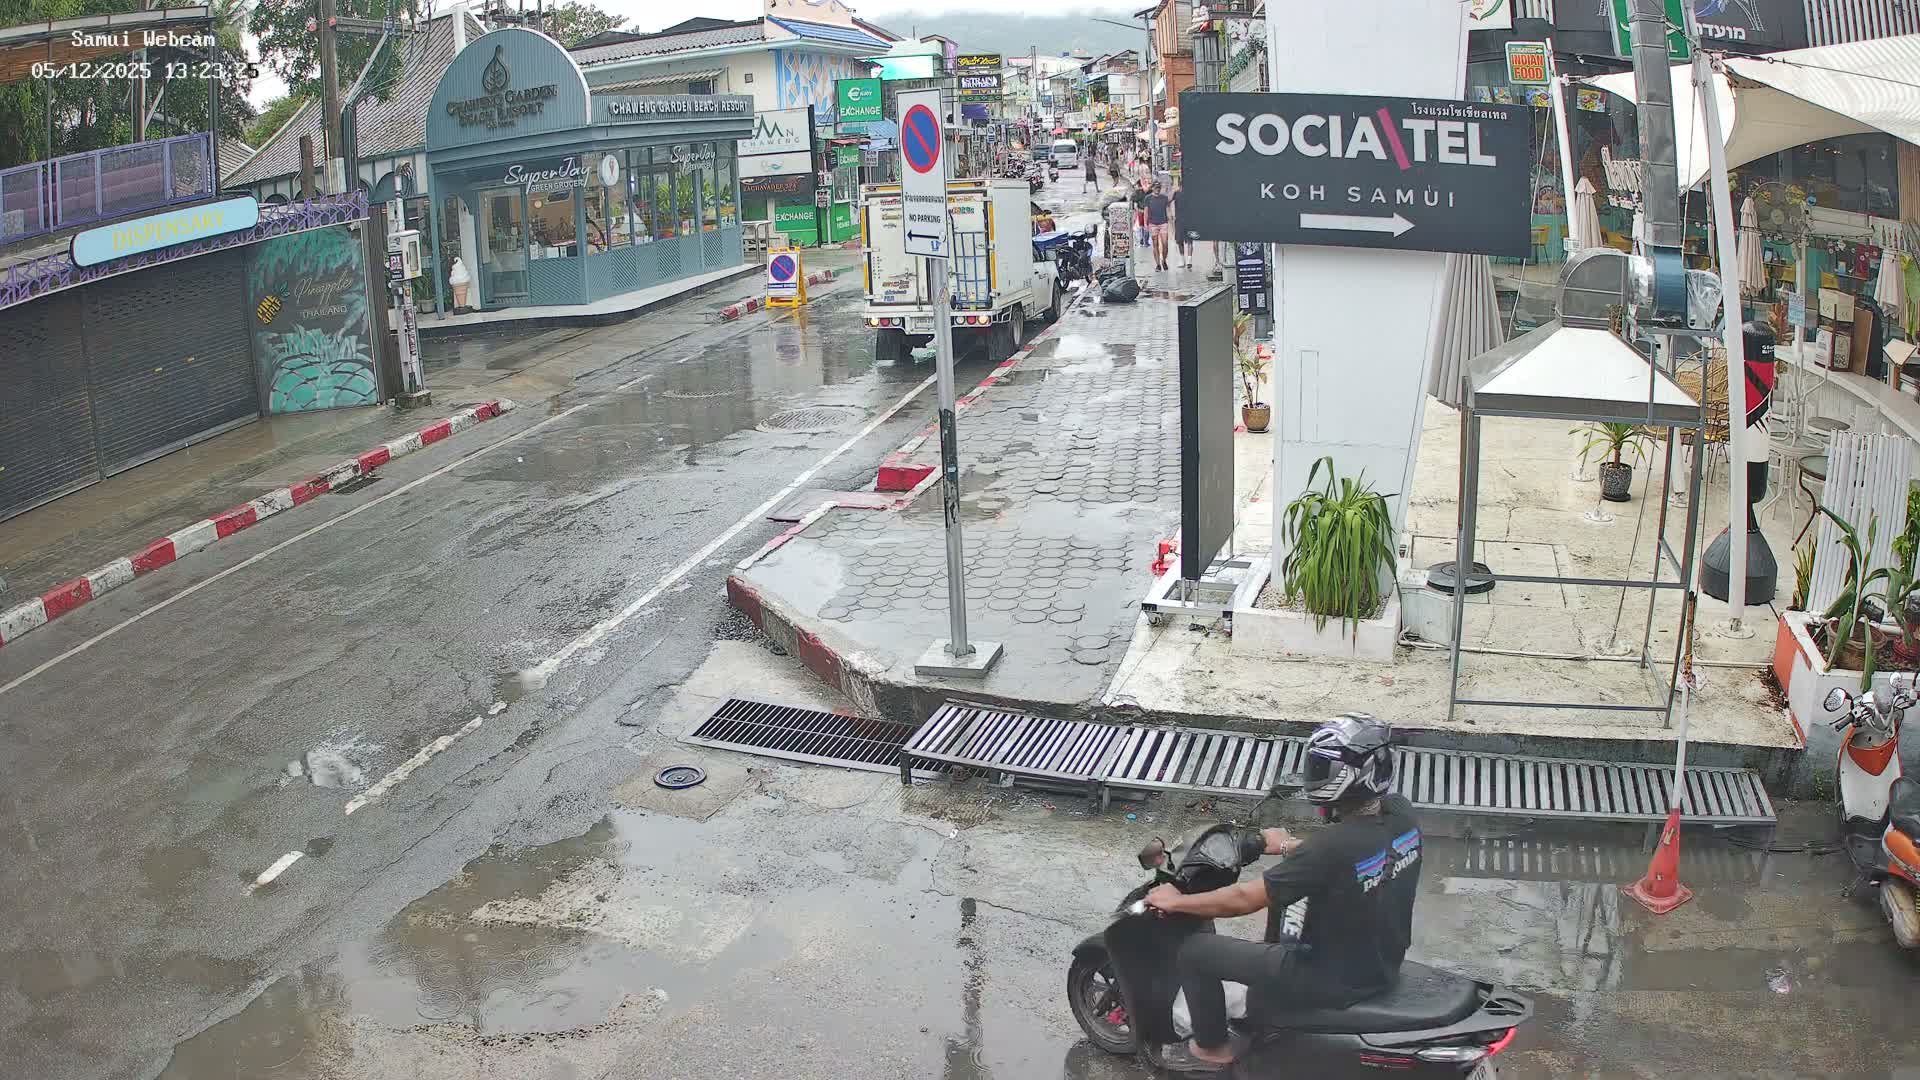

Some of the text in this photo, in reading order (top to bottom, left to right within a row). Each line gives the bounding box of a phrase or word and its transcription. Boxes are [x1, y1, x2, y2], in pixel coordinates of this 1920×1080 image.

[1511, 54, 1544, 66] INDIAN
[1513, 66, 1543, 80] FOOD
[612, 100, 748, 115] CHAWENG GARDEN BEACH RESORT
[840, 105, 881, 117] EXCHANGE
[741, 136, 800, 148] CHAWENG
[672, 143, 716, 176] SuperJay
[504, 157, 591, 195] SuperJay
[531, 182, 553, 192] GREEN
[1260, 182, 1455, 208] KOH SAMUI
[775, 211, 814, 222] EXCHANGE
[909, 213, 941, 224] NO PARKING
[113, 209, 225, 251] DISPENSARY
[302, 305, 348, 318] THAILAND
